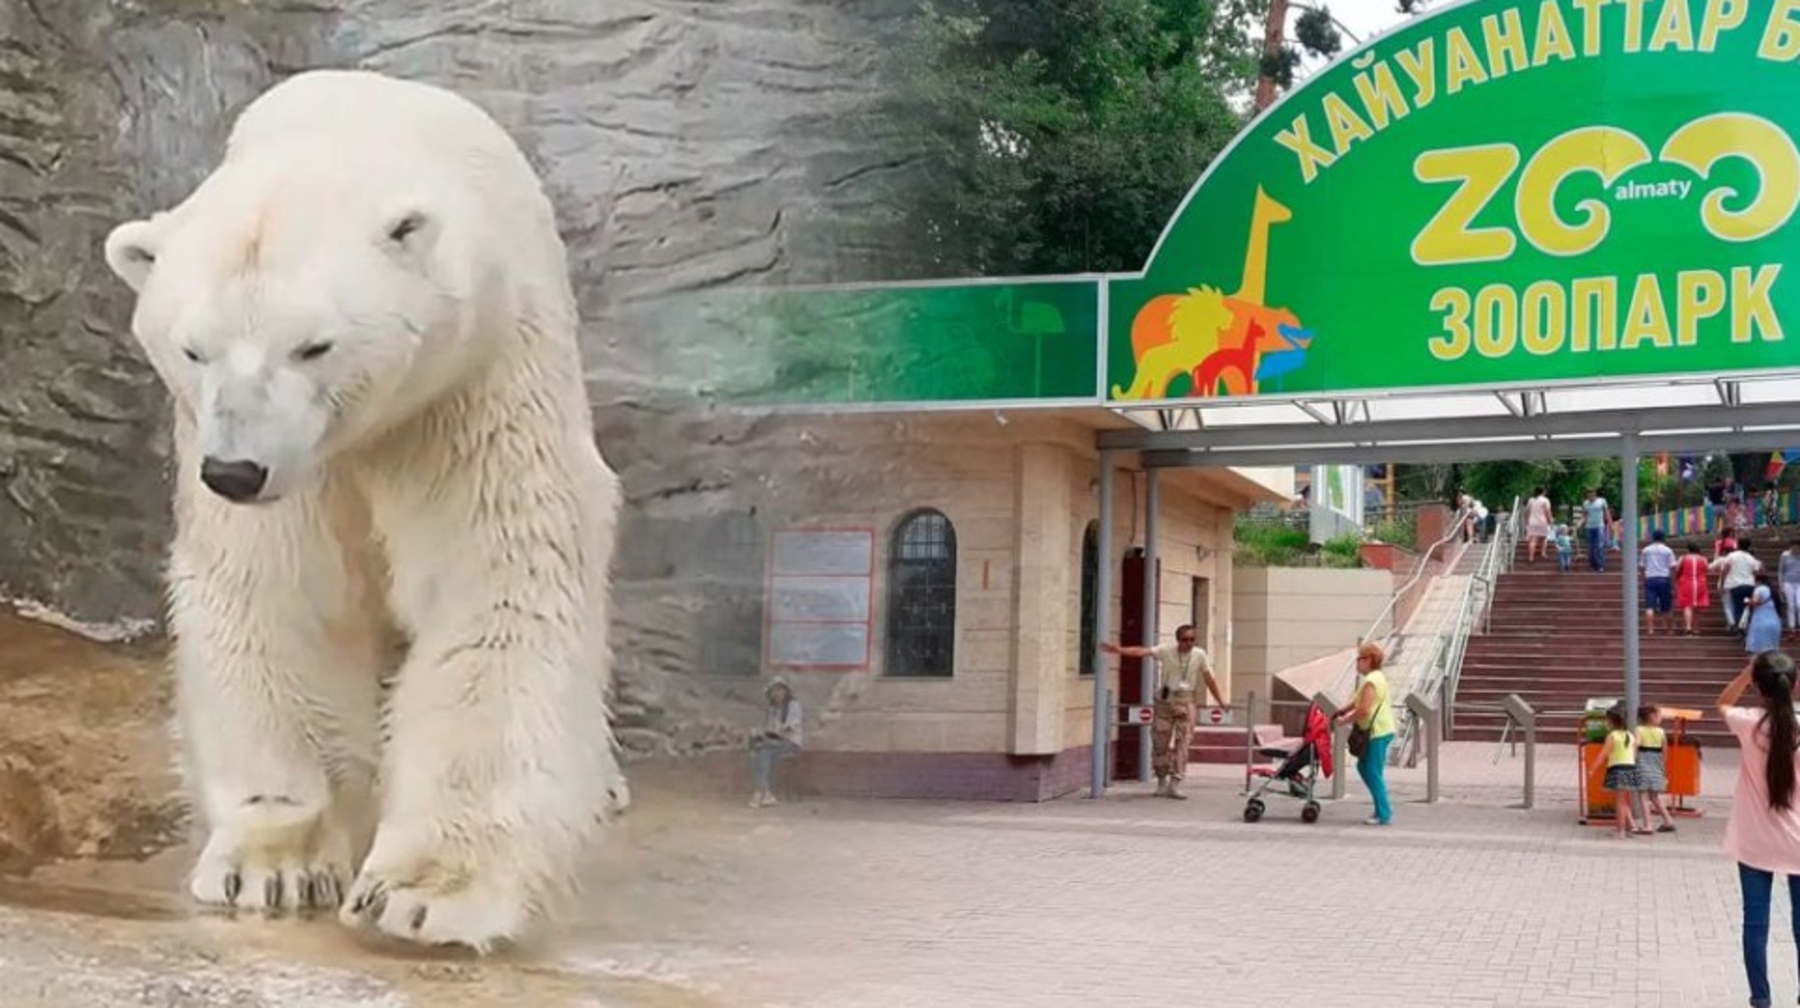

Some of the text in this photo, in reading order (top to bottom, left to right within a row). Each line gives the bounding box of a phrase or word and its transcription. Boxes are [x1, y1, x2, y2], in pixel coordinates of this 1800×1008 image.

[1273, 0, 1749, 184] ХАЙУАНАТТАР
[1410, 111, 1800, 266] ZOO
[1615, 179, 1692, 201] almaty
[1428, 263, 1785, 360] ЗООПАРК
